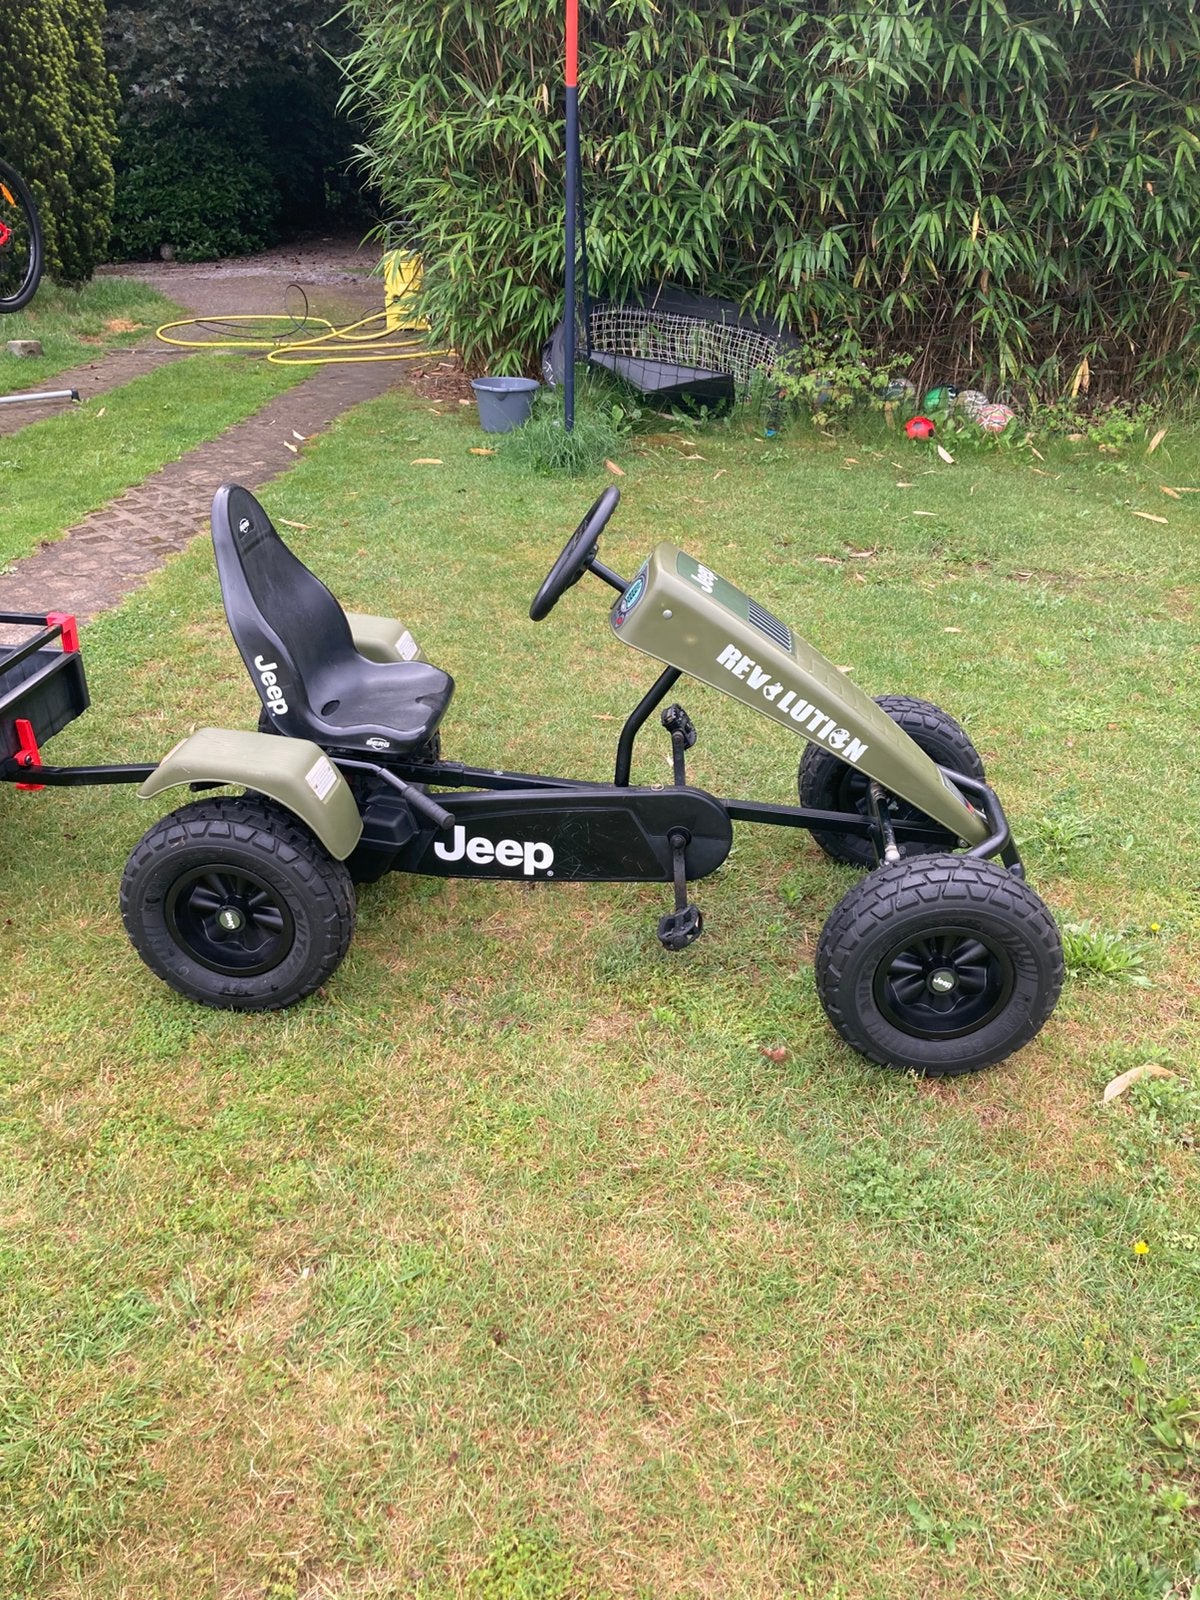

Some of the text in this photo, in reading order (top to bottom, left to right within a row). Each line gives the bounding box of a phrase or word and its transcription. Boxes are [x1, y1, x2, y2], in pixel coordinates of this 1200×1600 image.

[691, 564, 718, 593] Jeep
[254, 654, 289, 715] Jeep
[434, 825, 554, 875] Jeep
[933, 976, 952, 989] Jeep
